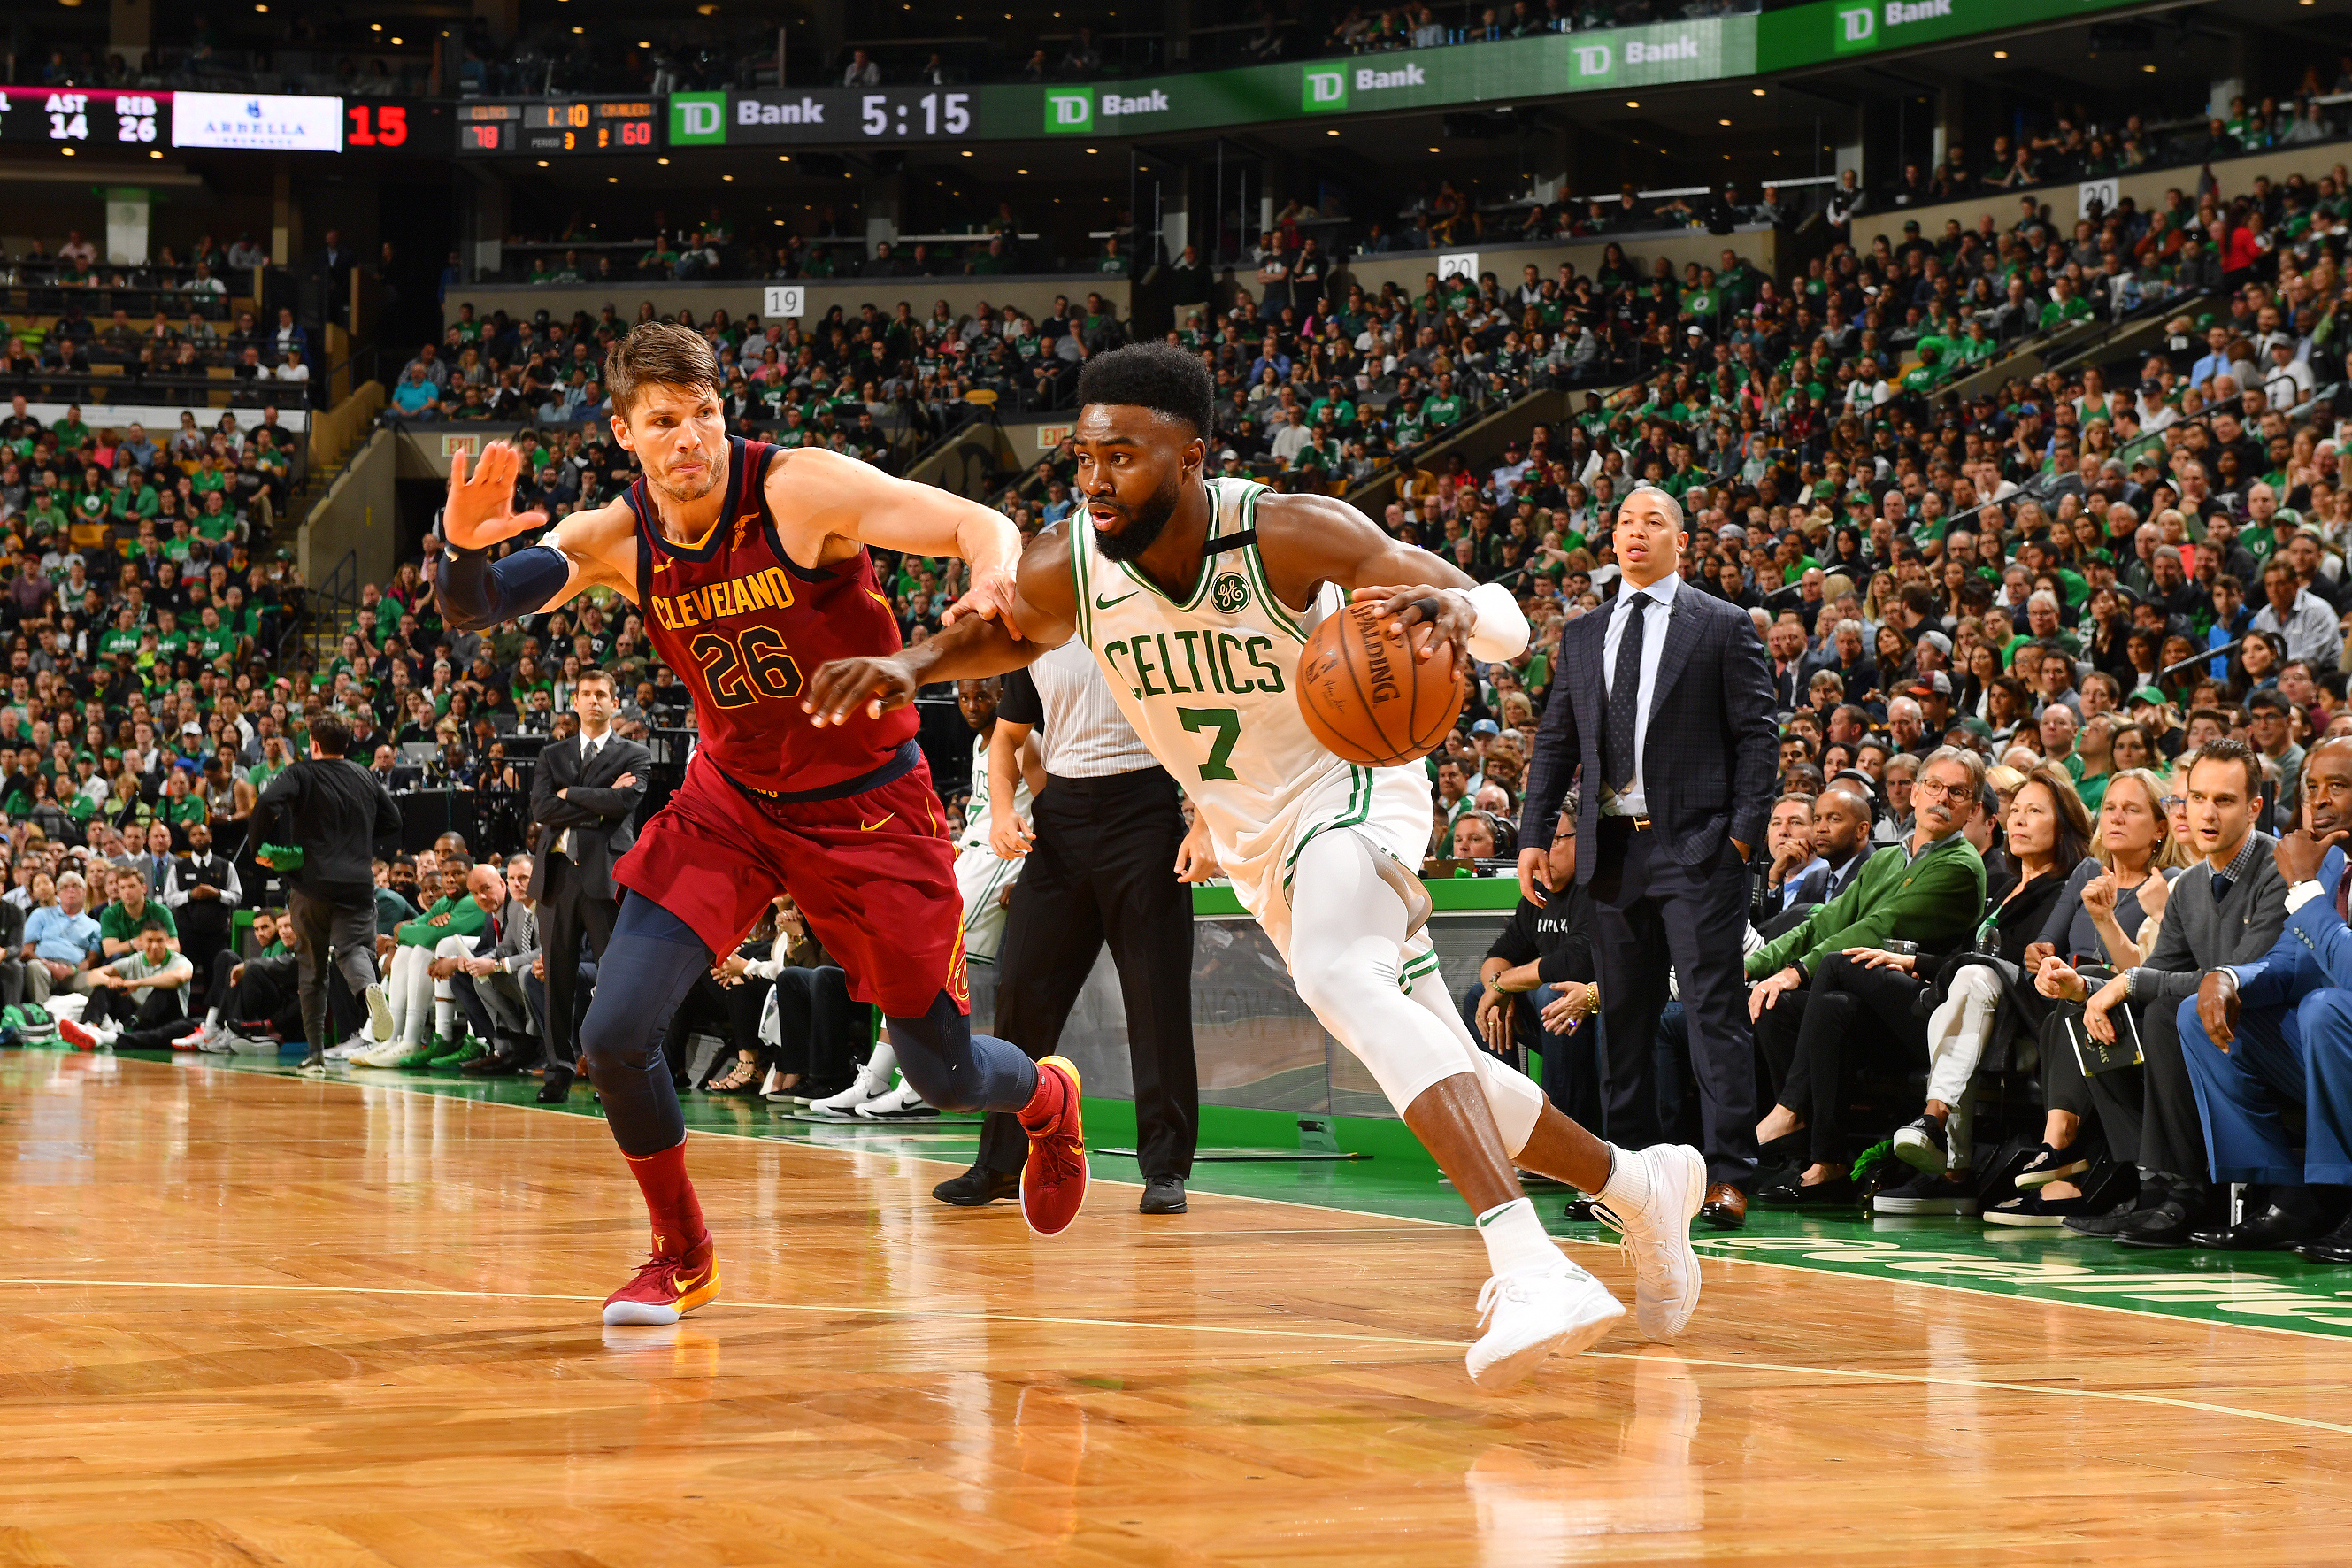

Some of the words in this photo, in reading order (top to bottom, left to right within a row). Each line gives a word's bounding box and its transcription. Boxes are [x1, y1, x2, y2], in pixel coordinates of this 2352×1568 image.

[1840, 7, 1873, 41] TD
[1884, 0, 1951, 26] Bank
[1573, 45, 1611, 76] TD
[1625, 35, 1698, 65] Bank
[1306, 72, 1344, 102] TD
[1356, 63, 1425, 90] Bank
[45, 93, 88, 114] AST
[115, 96, 158, 116] REB
[674, 101, 721, 135] TD
[737, 96, 824, 126] Bank
[862, 93, 970, 135] 5:15
[1049, 96, 1088, 125] TD
[1102, 89, 1169, 116] Bank
[49, 114, 88, 140] 14
[118, 116, 158, 142] 26
[348, 105, 408, 146] 15
[622, 122, 651, 145] 60
[771, 290, 796, 312] 19
[651, 566, 796, 632] CLEVELAND
[689, 625, 804, 709] 26
[1103, 629, 1286, 701] CELTICS
[1348, 603, 1401, 706] SPALDING
[1175, 706, 1241, 782] 7
